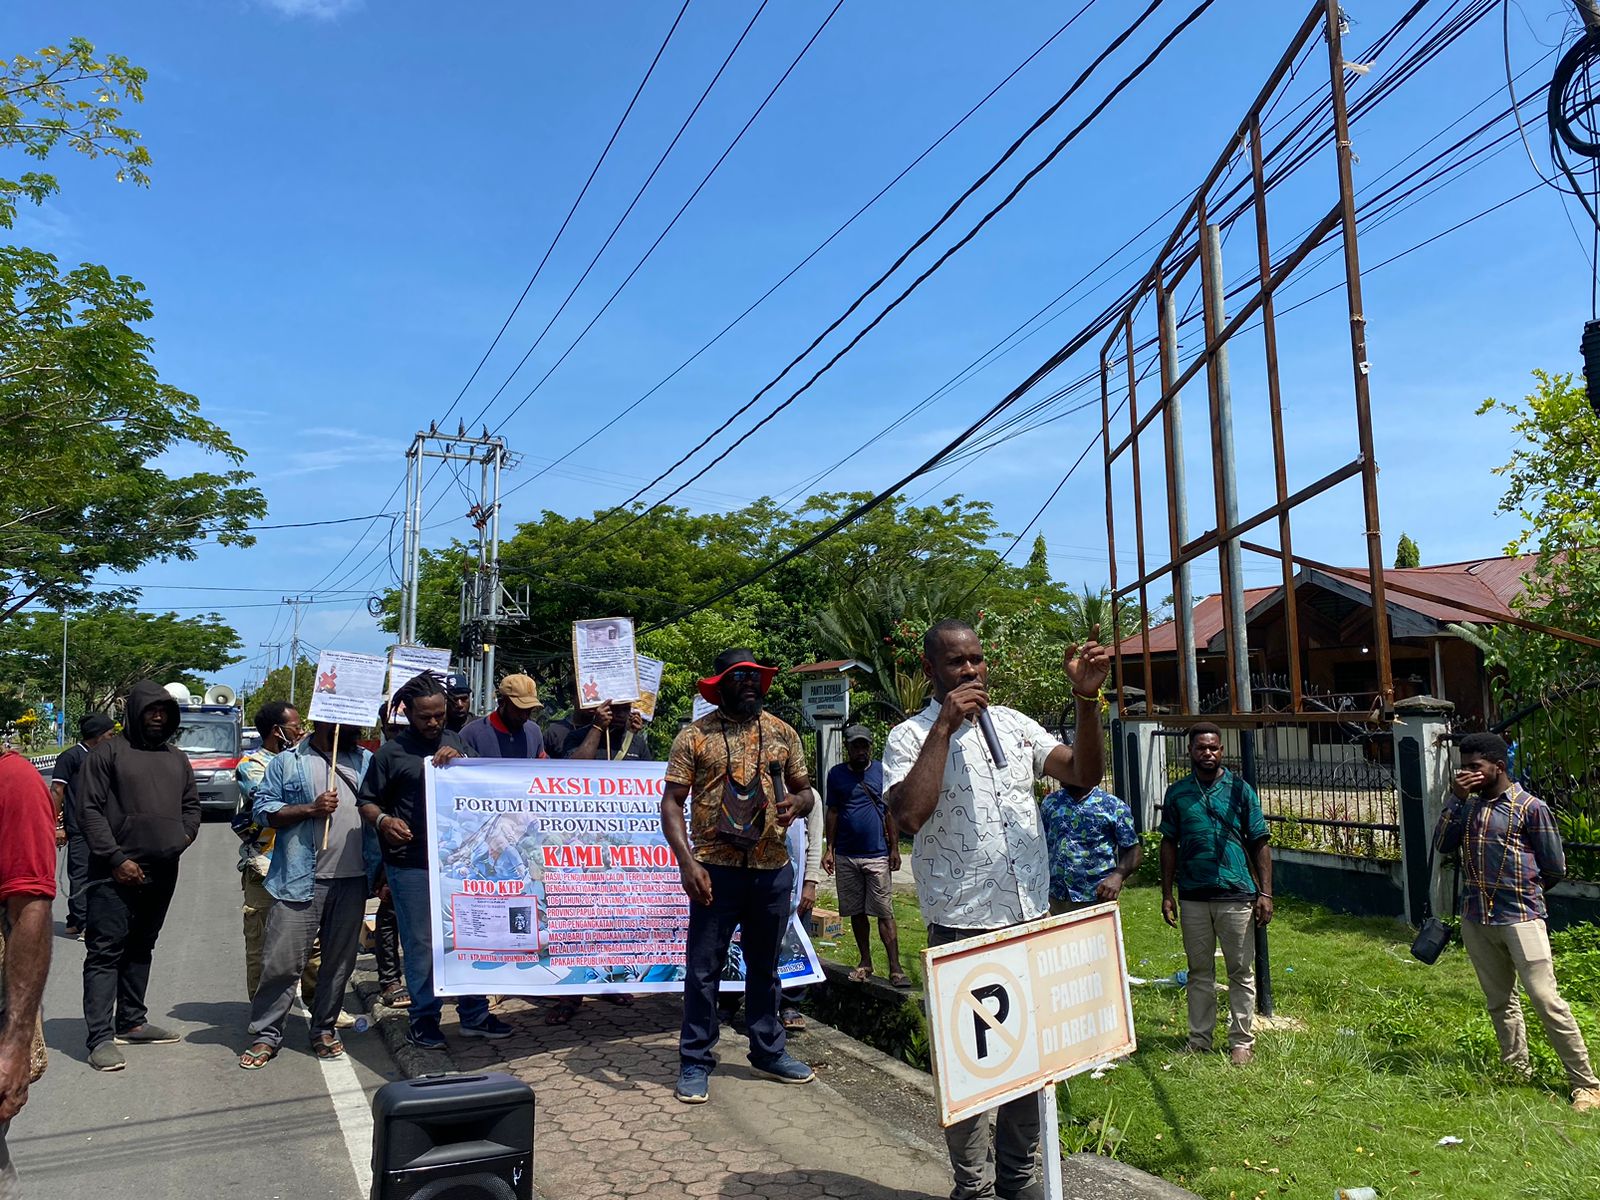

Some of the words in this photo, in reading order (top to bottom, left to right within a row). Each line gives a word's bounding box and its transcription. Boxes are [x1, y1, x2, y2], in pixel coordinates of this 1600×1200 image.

[528, 777, 592, 795] AKSI
[455, 798, 523, 813] FORUM
[528, 799, 652, 814] INTELEKTUAL
[539, 819, 623, 832] PROVINSI
[629, 820, 660, 832] PAP
[543, 846, 604, 867] KAMI
[545, 873, 562, 881] HASIL
[564, 873, 605, 882] PENGUMUMAN
[606, 873, 624, 881] CALON
[626, 873, 650, 881] TERPILIH
[651, 873, 662, 881] DAN
[463, 880, 495, 893] FOTO
[498, 880, 524, 894] KTP
[546, 884, 570, 893] DENGAN
[618, 884, 630, 893] DAN
[561, 896, 580, 905] TAHUN
[548, 909, 576, 918] PROVINSI
[577, 909, 596, 917] PAPUA
[597, 909, 611, 917] OLEH
[549, 921, 567, 929] JALUR
[568, 920, 613, 928] PENGANGKATAN
[549, 933, 567, 941] MASA
[568, 933, 584, 941] BARU
[577, 945, 596, 953] JALUR
[551, 957, 575, 966] APAKAH
[607, 956, 636, 965] INDONESIA
[671, 956, 686, 964] SEPER
[1036, 934, 1108, 977] DILARANG
[1051, 973, 1104, 1013] PARKIR
[1042, 1028, 1059, 1056] DI
[1061, 1015, 1096, 1048] AREA
[1100, 1004, 1119, 1033] INI
